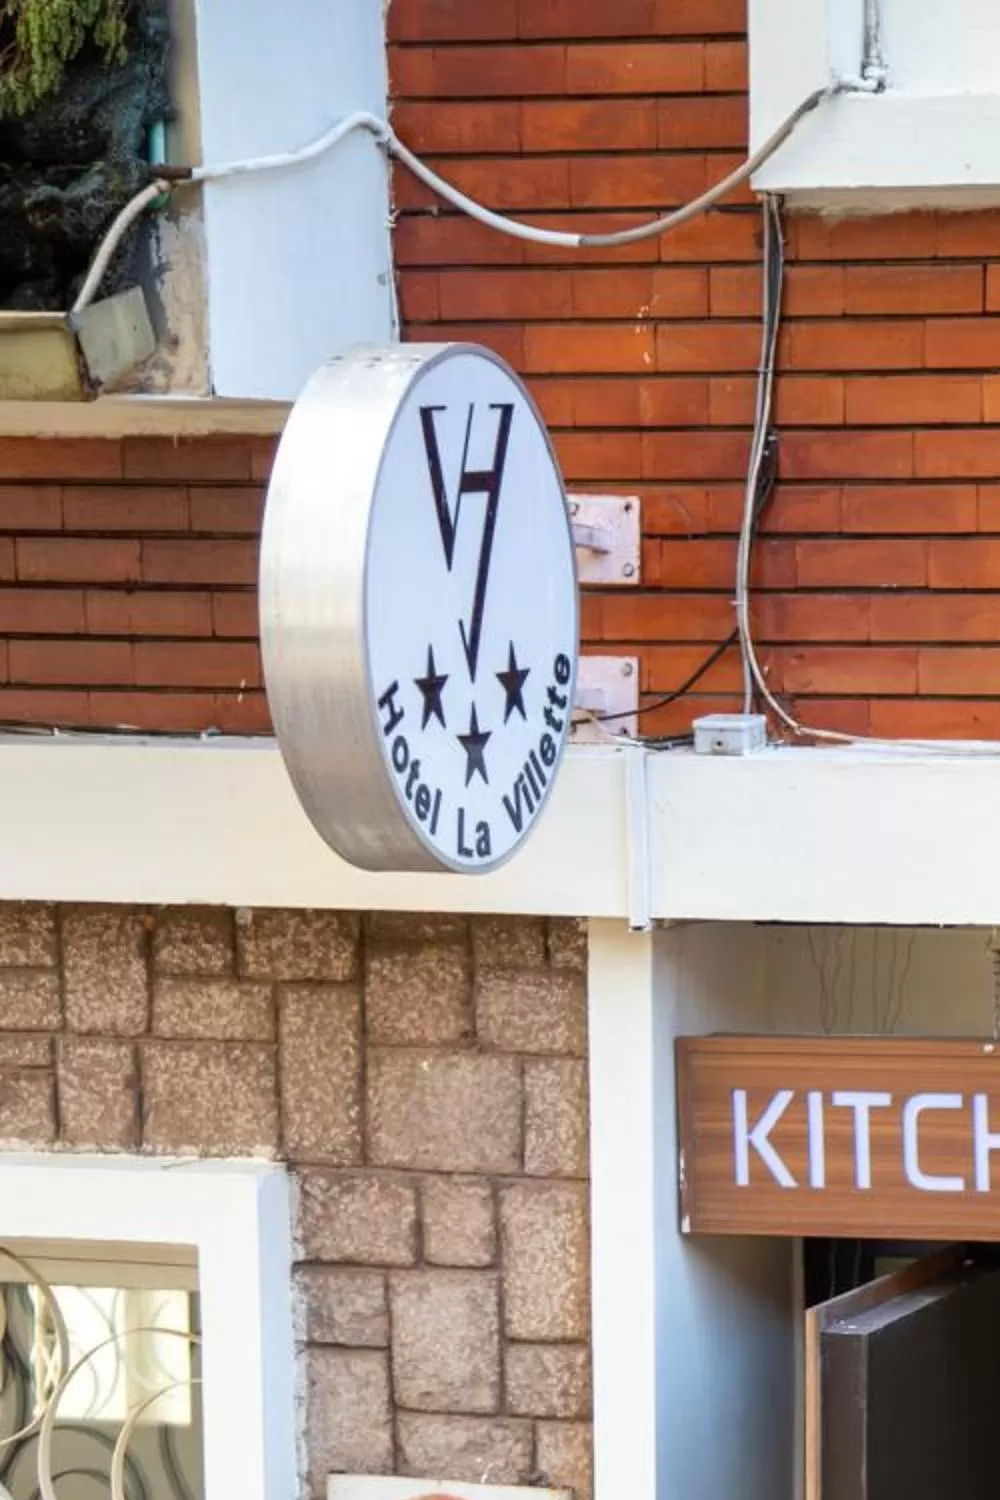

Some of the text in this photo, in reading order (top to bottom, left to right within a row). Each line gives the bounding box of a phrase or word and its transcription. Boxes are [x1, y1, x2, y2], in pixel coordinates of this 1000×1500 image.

[377, 653, 571, 858] Hotel La Villette
